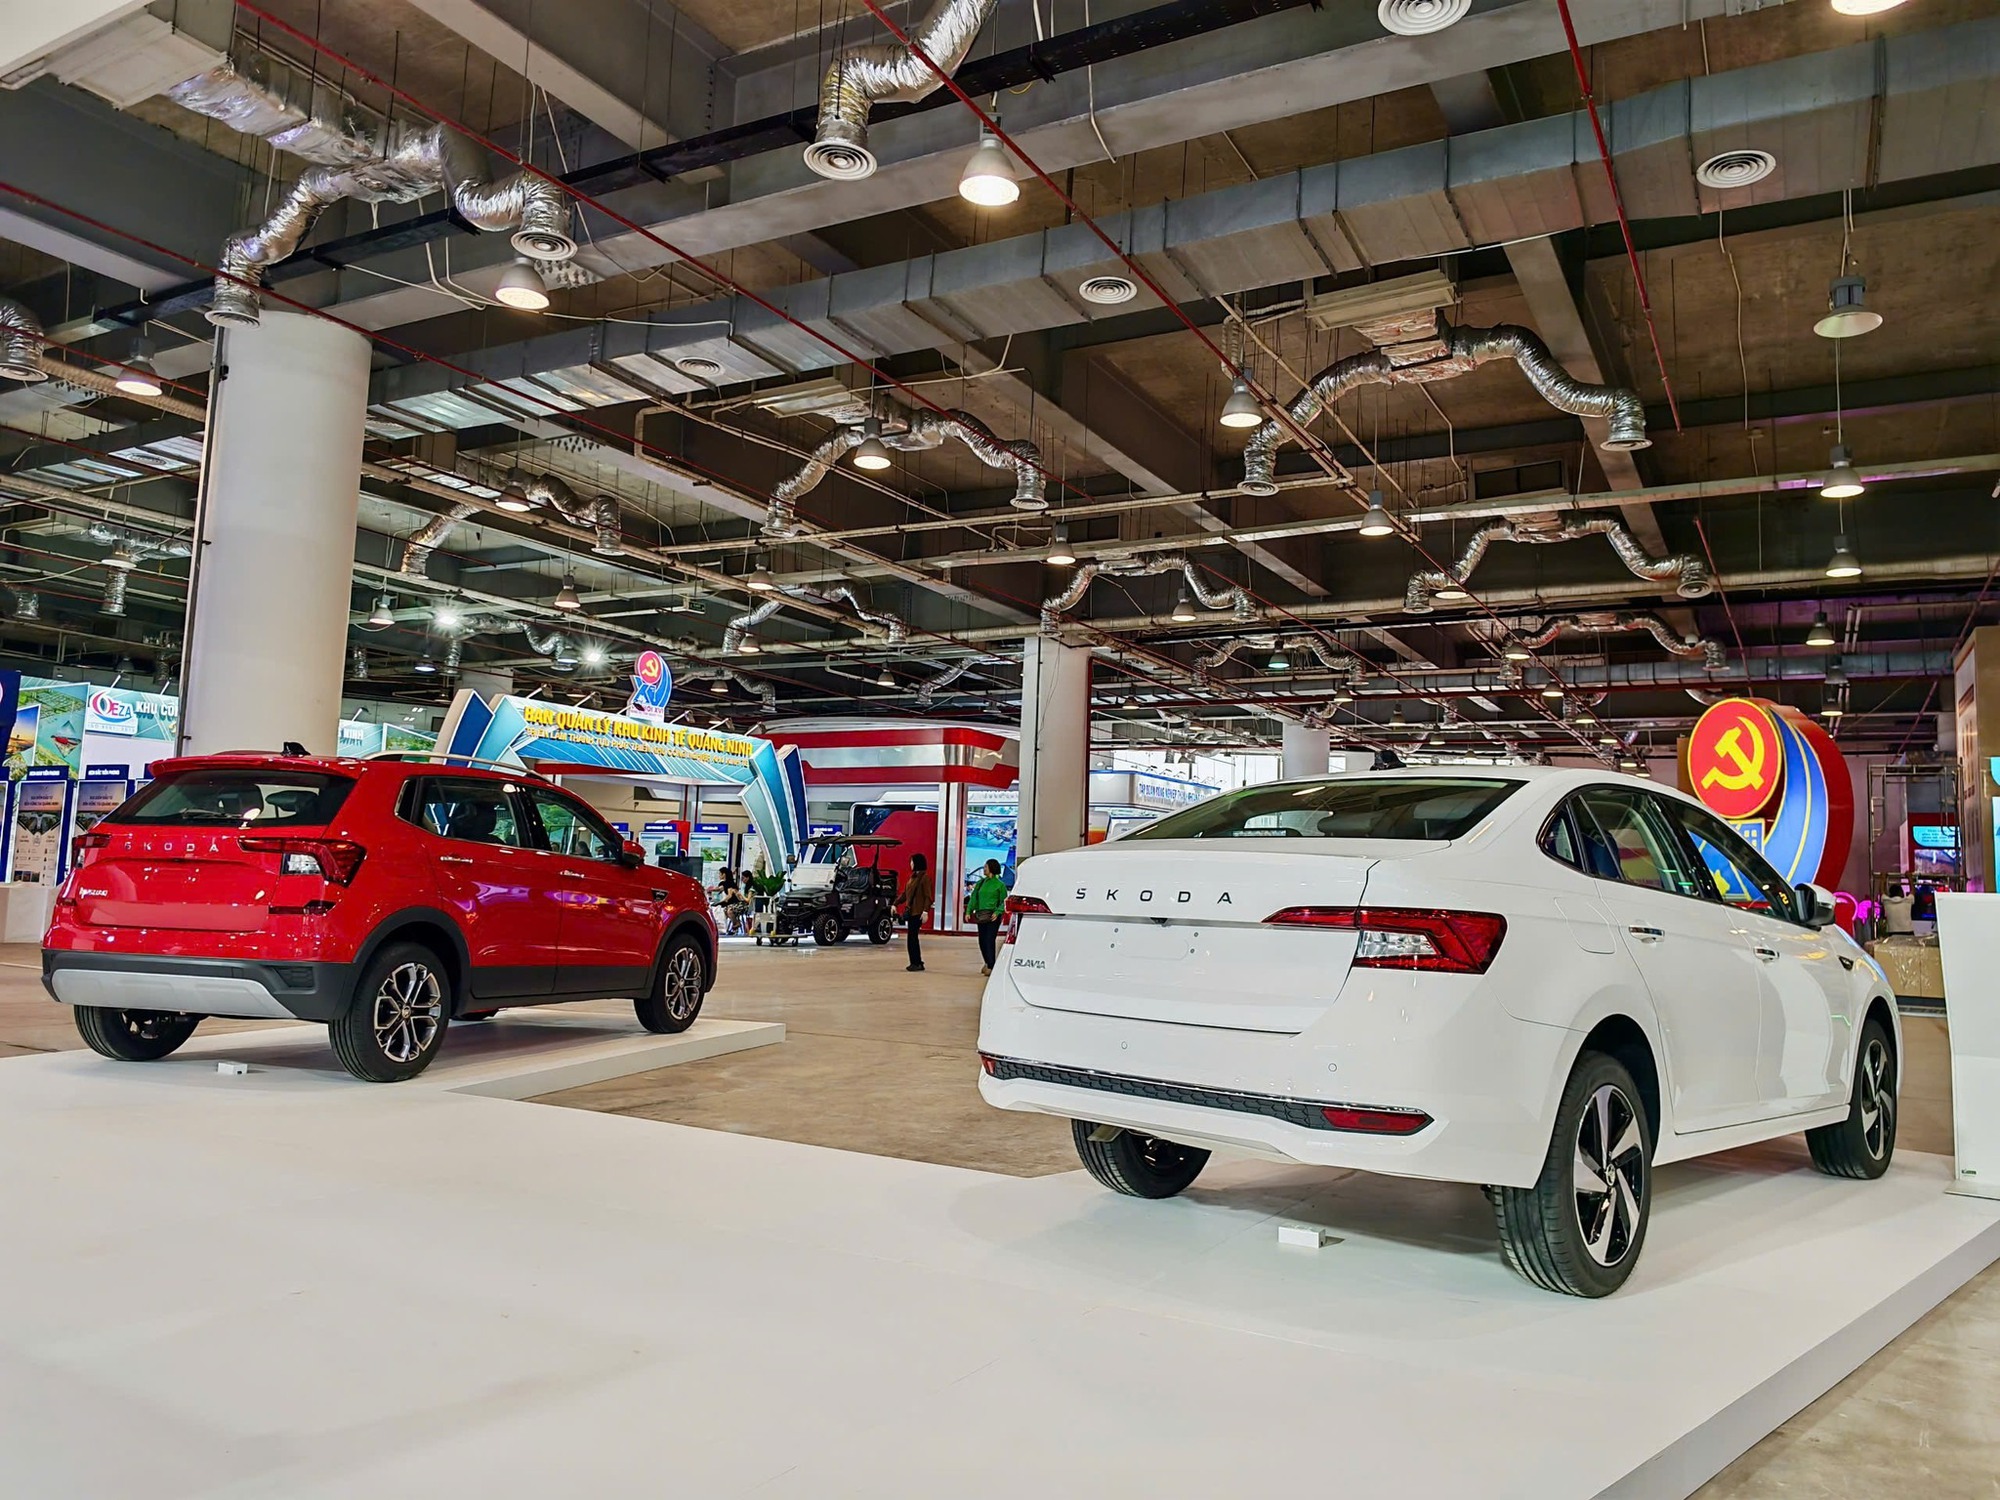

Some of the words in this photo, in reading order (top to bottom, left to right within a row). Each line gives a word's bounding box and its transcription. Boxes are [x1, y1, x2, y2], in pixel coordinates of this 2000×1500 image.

[135, 701, 157, 714] KHU
[524, 706, 553, 725] BAN
[556, 711, 594, 731] QUẢN
[596, 716, 611, 735] LÝ
[613, 721, 639, 739] KHU
[641, 725, 671, 744] KINH
[672, 728, 688, 746] TẾ
[688, 733, 724, 752] QUẢNG
[726, 740, 753, 757] NINH
[1014, 958, 1046, 970] SLAVIA
